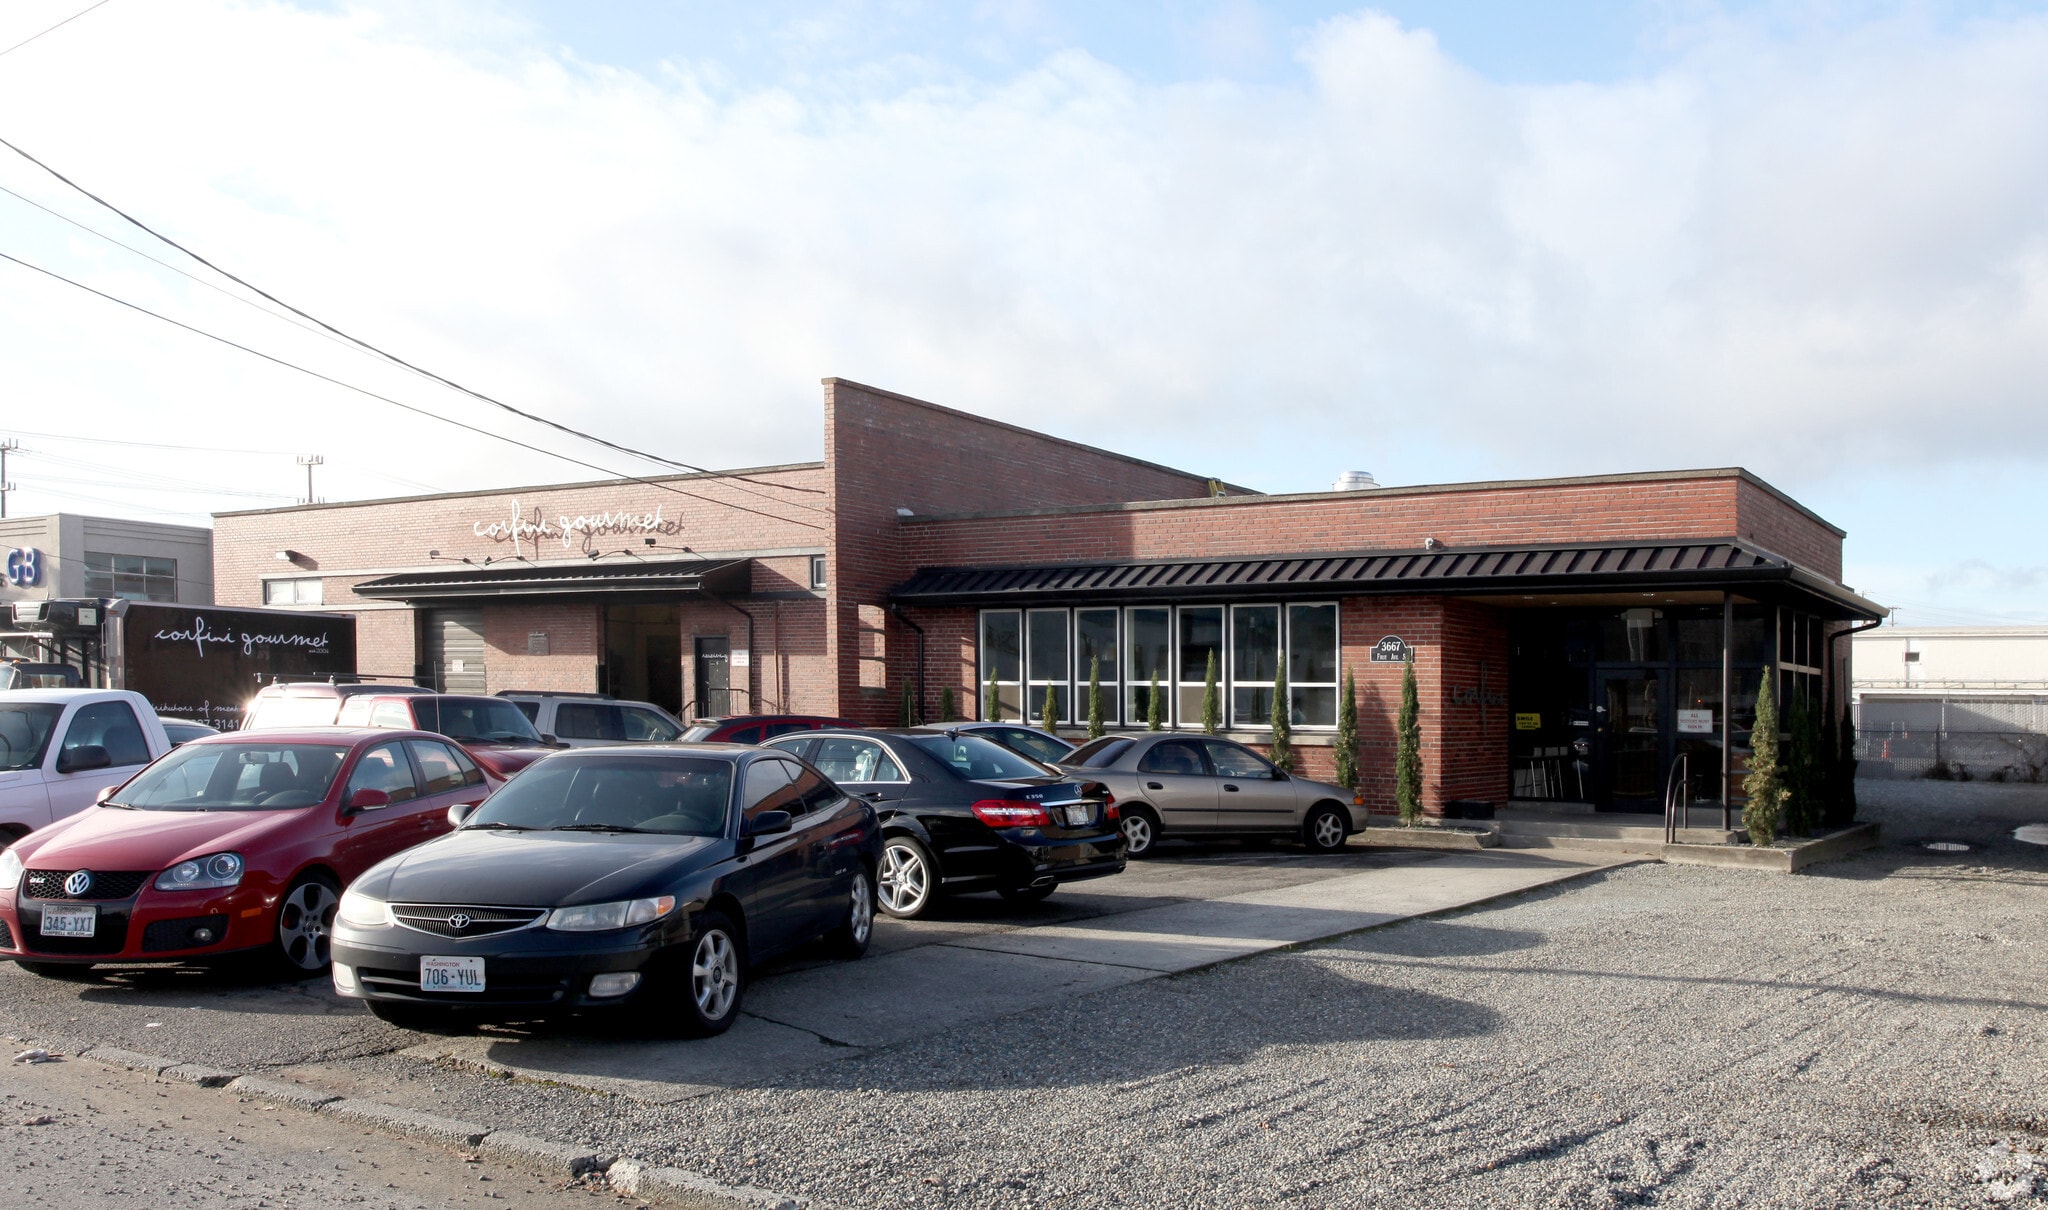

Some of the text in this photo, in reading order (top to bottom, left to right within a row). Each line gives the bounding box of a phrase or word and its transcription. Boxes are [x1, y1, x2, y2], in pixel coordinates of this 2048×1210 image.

[474, 499, 663, 557] corfini gourmet
[155, 616, 329, 657] corfini gourmet
[1381, 641, 1401, 651] 3667
[197, 700, 210, 718] of
[425, 969, 482, 986] 706-YUL
